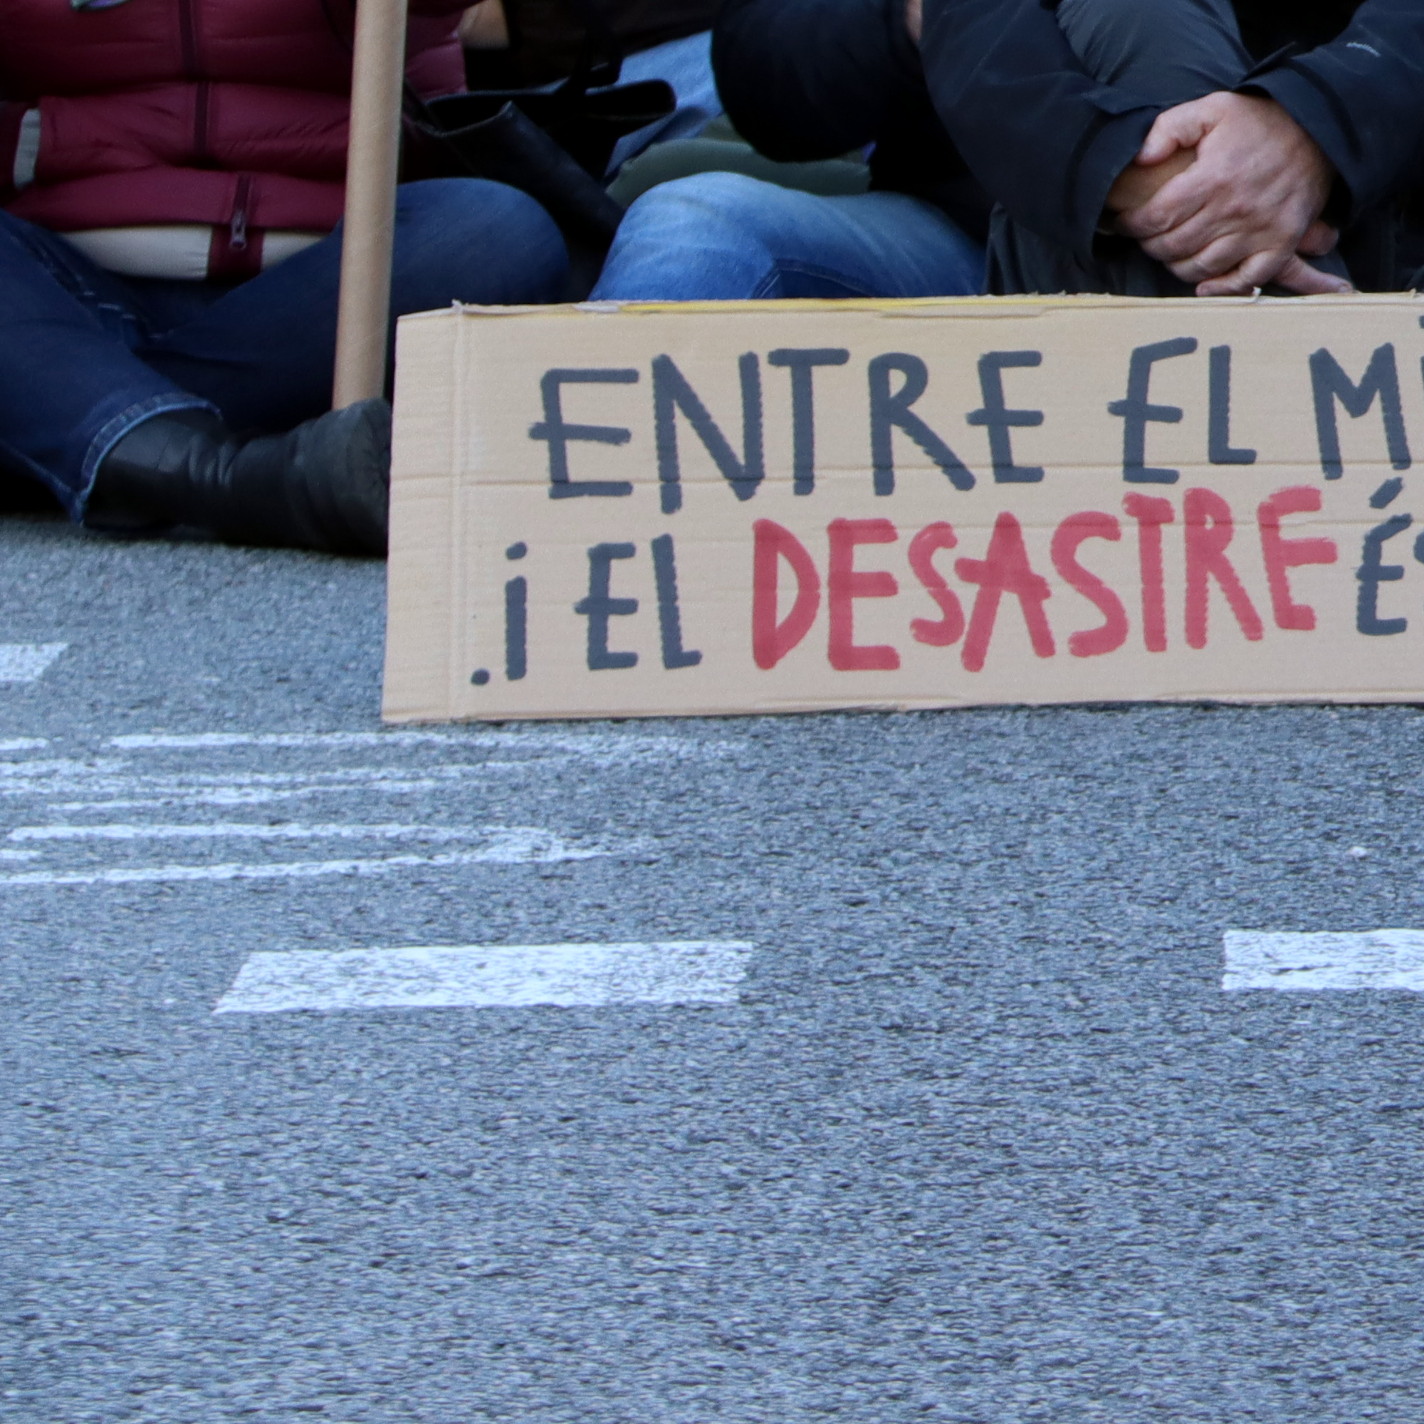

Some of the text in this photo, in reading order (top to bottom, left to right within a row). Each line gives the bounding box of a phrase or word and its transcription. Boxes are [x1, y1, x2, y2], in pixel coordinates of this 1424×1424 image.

[528, 348, 1045, 514] ENTRE
[1108, 337, 1258, 485] EL
[575, 534, 703, 671] EL
[753, 488, 1337, 671] DESASTRE
